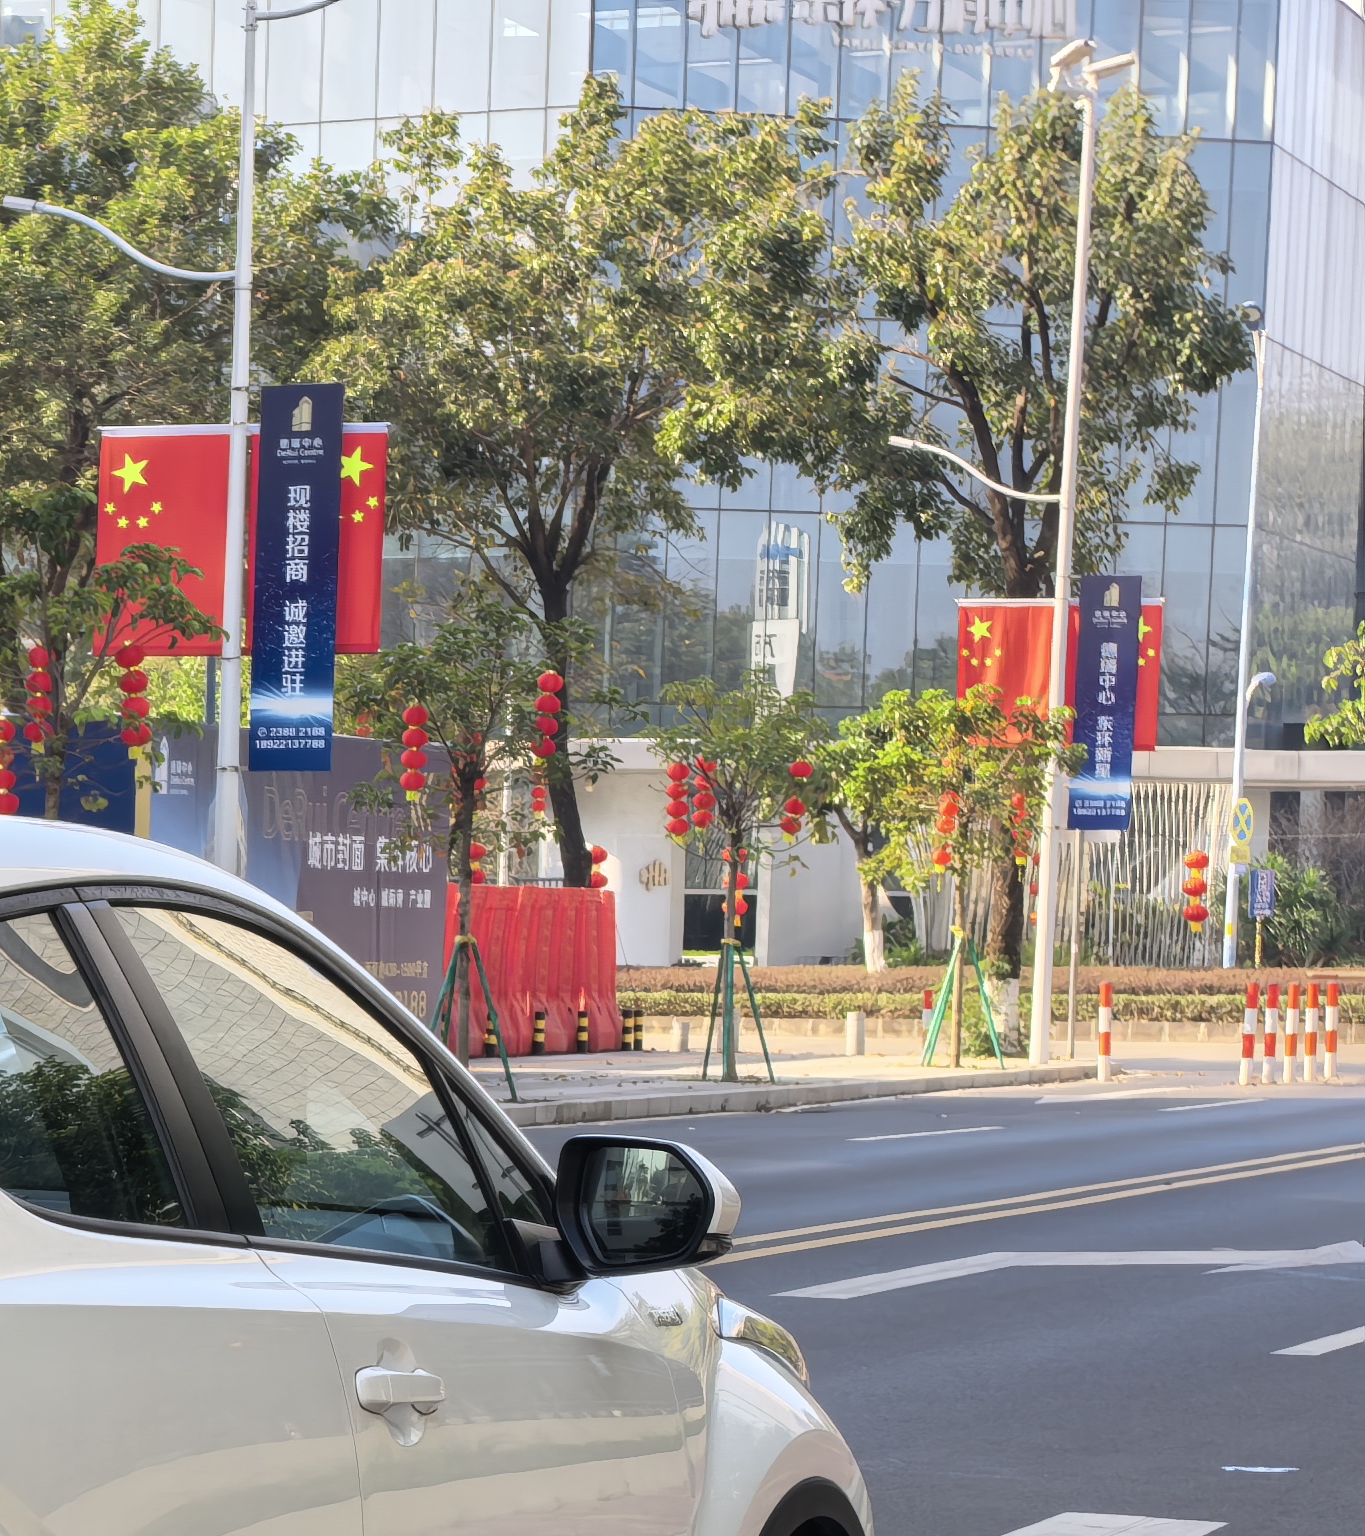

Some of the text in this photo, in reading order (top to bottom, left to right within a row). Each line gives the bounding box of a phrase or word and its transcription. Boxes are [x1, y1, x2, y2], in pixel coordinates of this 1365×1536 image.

[285, 485, 311, 583] 现楼招商
[280, 599, 308, 697] 诚邀进驻
